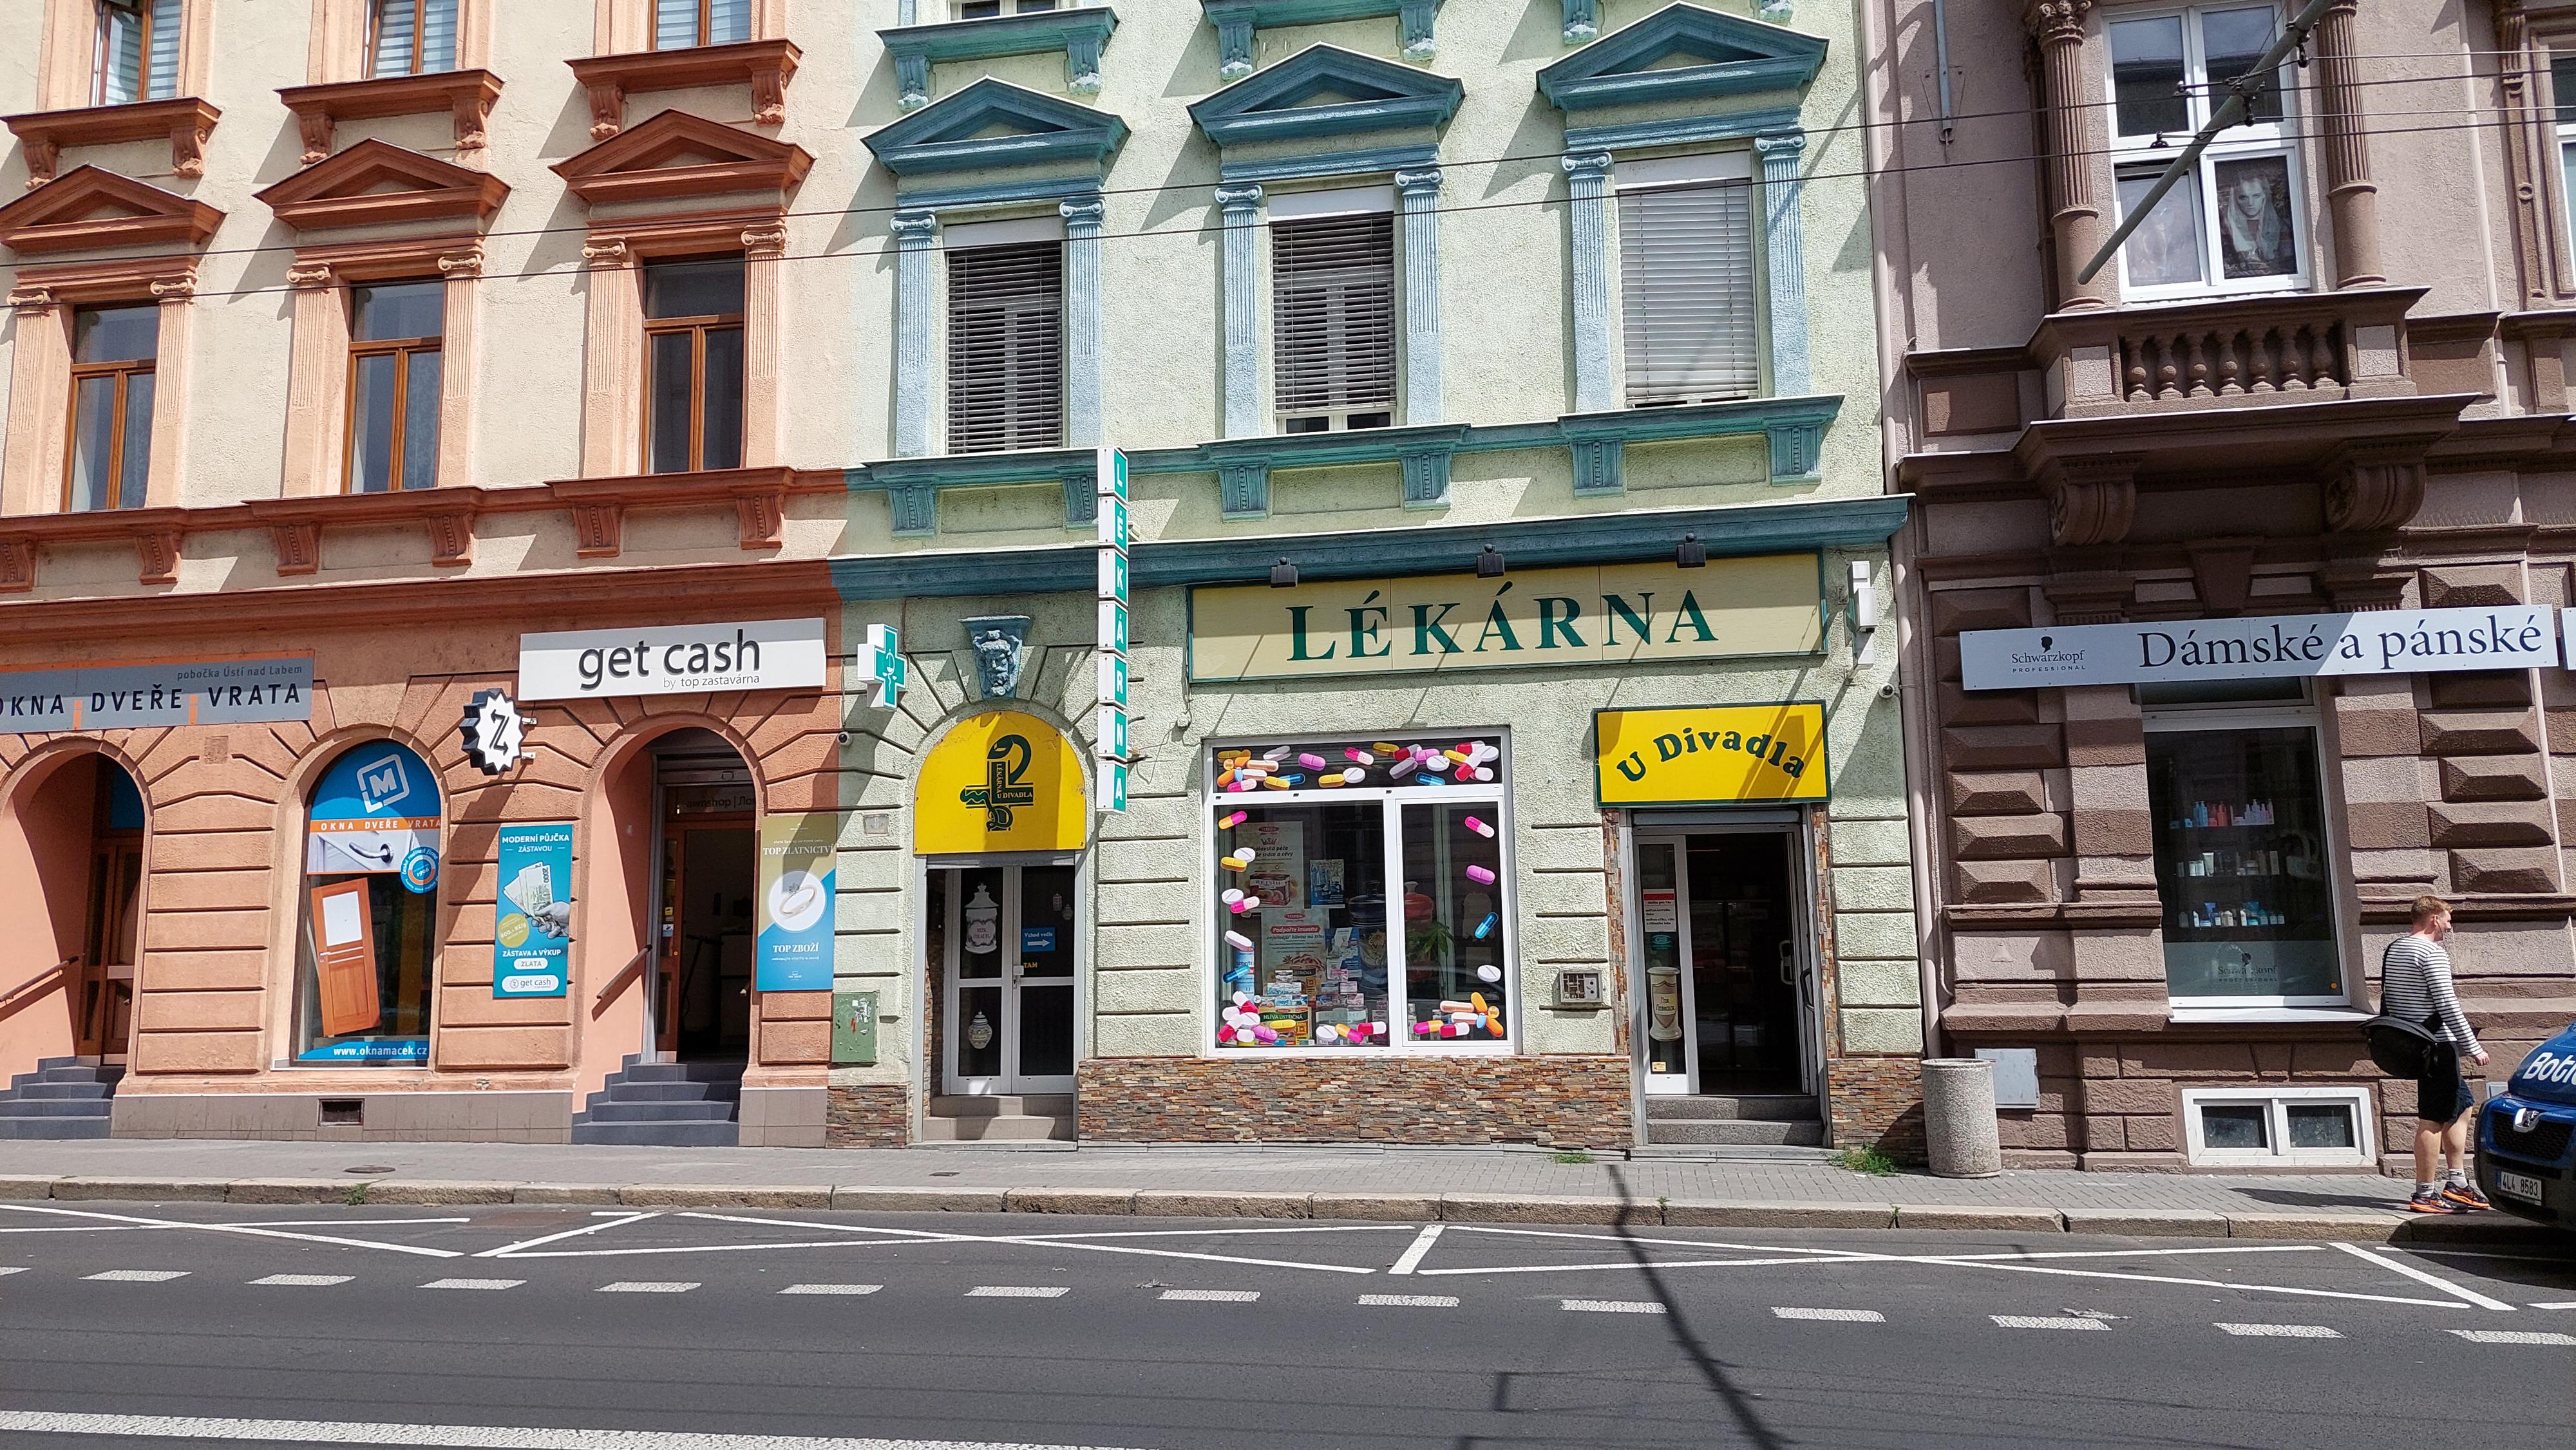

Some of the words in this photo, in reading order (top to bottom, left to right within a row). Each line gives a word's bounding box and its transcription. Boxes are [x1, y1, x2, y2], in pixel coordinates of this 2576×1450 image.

[1285, 580, 1719, 662] LÉKÁRNA
[2137, 623, 2324, 668] Dámské
[2340, 634, 2364, 659] a
[2378, 614, 2543, 670] pánské
[578, 641, 650, 691] get
[663, 628, 761, 676] cash
[2011, 650, 2085, 664] Schwarzkopf
[177, 668, 220, 681] pobočka
[223, 665, 244, 677] Ústí
[247, 666, 265, 675] nad
[269, 665, 302, 675] Labem
[2012, 665, 2085, 673] PROFESSIONAL
[663, 677, 676, 690] by
[680, 677, 699, 690] top
[701, 673, 760, 686] zastavárna
[0, 694, 64, 717] KNA
[91, 683, 182, 712] DVEŘE
[208, 683, 300, 707] VRATA
[1616, 749, 1647, 782] U
[1653, 726, 1805, 778] Divadla
[369, 767, 397, 798] M
[321, 822, 354, 831] OKNA
[365, 819, 398, 829] DVEŘE
[408, 819, 440, 828] VRATA
[502, 833, 538, 843] MODERNÍ
[539, 833, 570, 842] PŮJČKA
[762, 847, 782, 856] TOP
[782, 843, 835, 855] ZLATNICTVÍ
[502, 949, 531, 957] ZÁSTAVA
[773, 945, 791, 953] TOP
[792, 942, 819, 953] ZBOŽÍ
[520, 979, 533, 988] get
[334, 1046, 427, 1056] www.oknamacek.cz
[2503, 1174, 2515, 1191] 4L4
[2520, 1179, 2538, 1196] 8583
